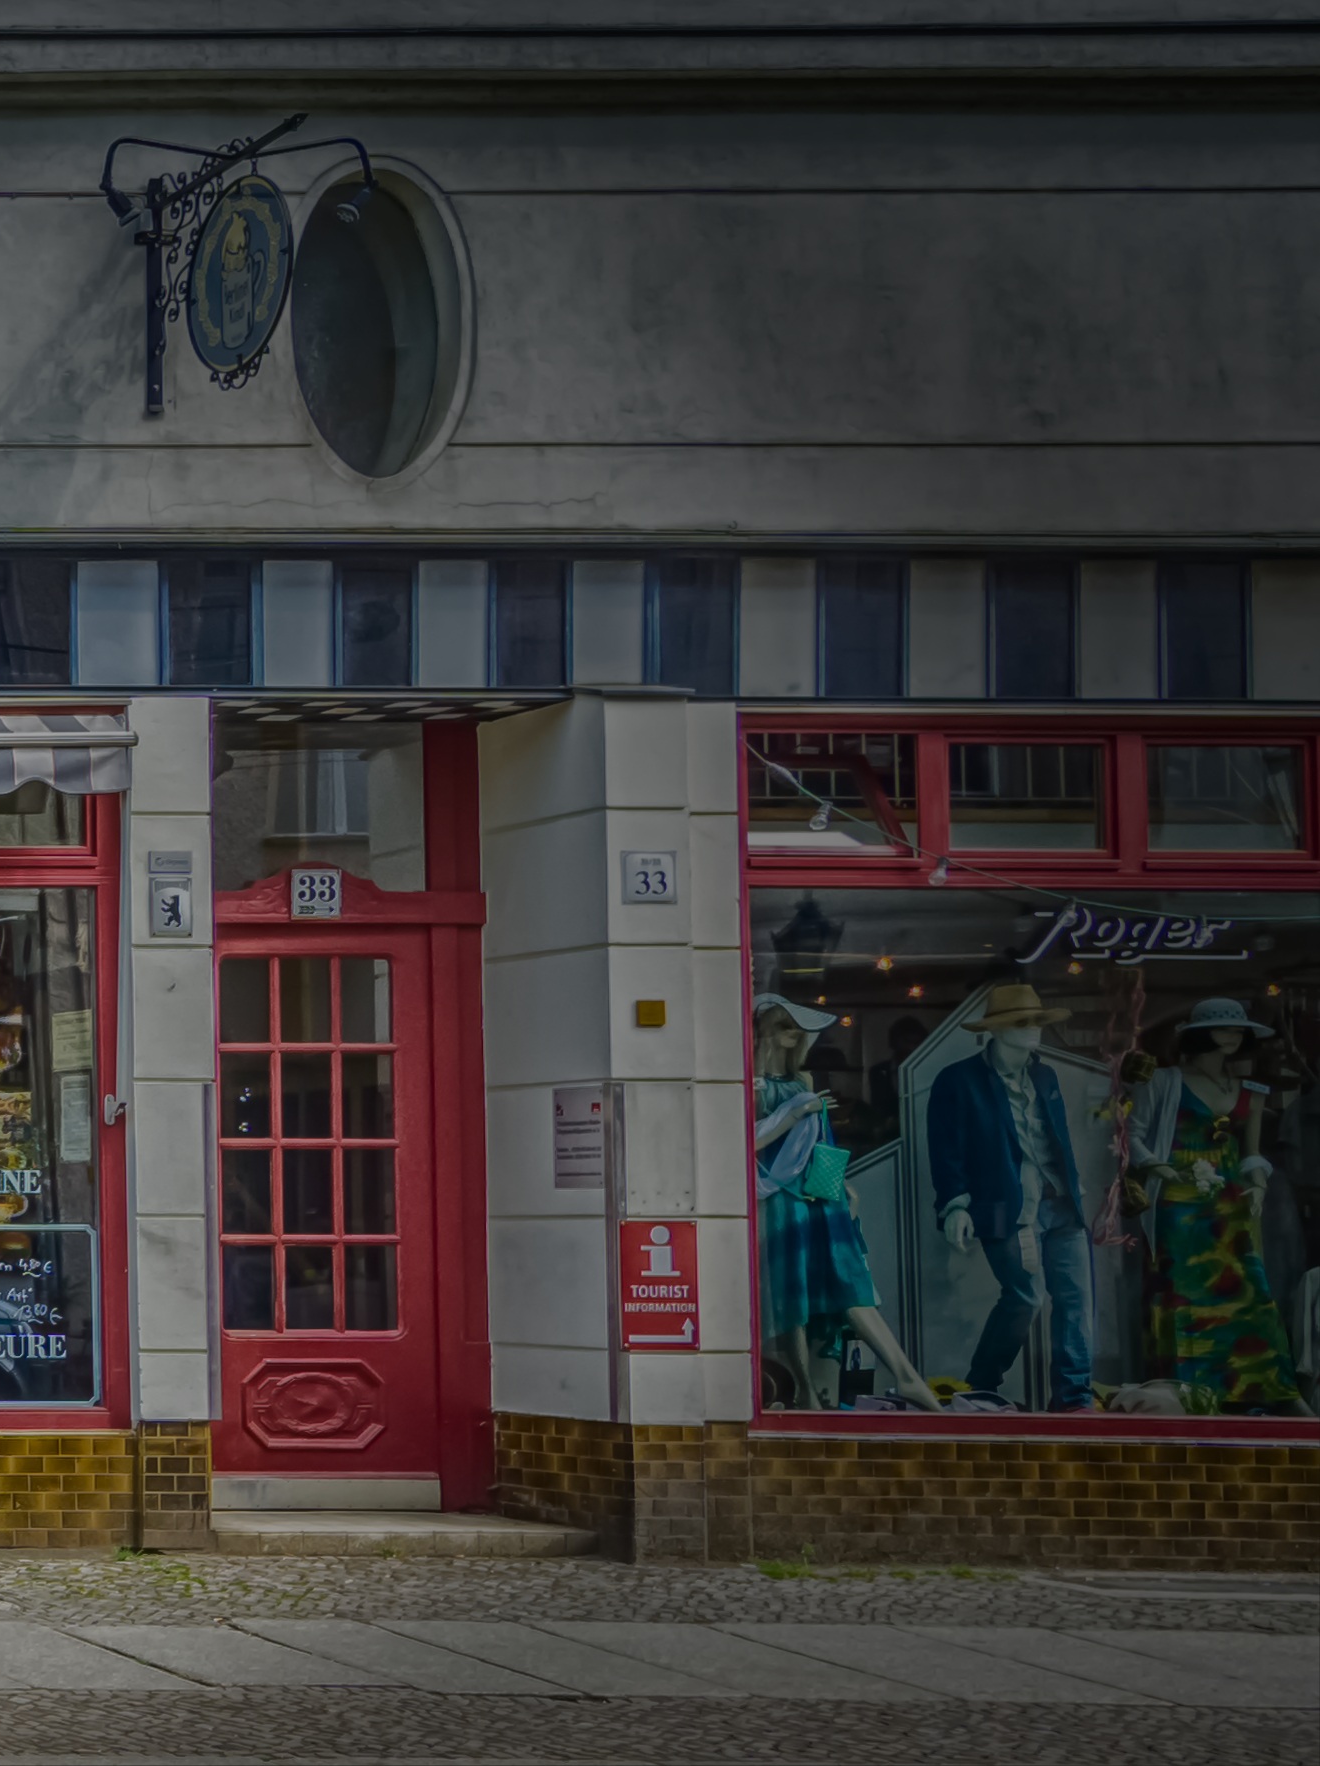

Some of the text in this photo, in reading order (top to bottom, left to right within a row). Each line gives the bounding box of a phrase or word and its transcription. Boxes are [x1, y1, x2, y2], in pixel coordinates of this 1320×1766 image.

[298, 875, 336, 902] 33
[635, 870, 668, 895] 33
[1016, 906, 1243, 963] Roger
[629, 1284, 690, 1298] TOURIST
[624, 1302, 697, 1312] INFORMATION
